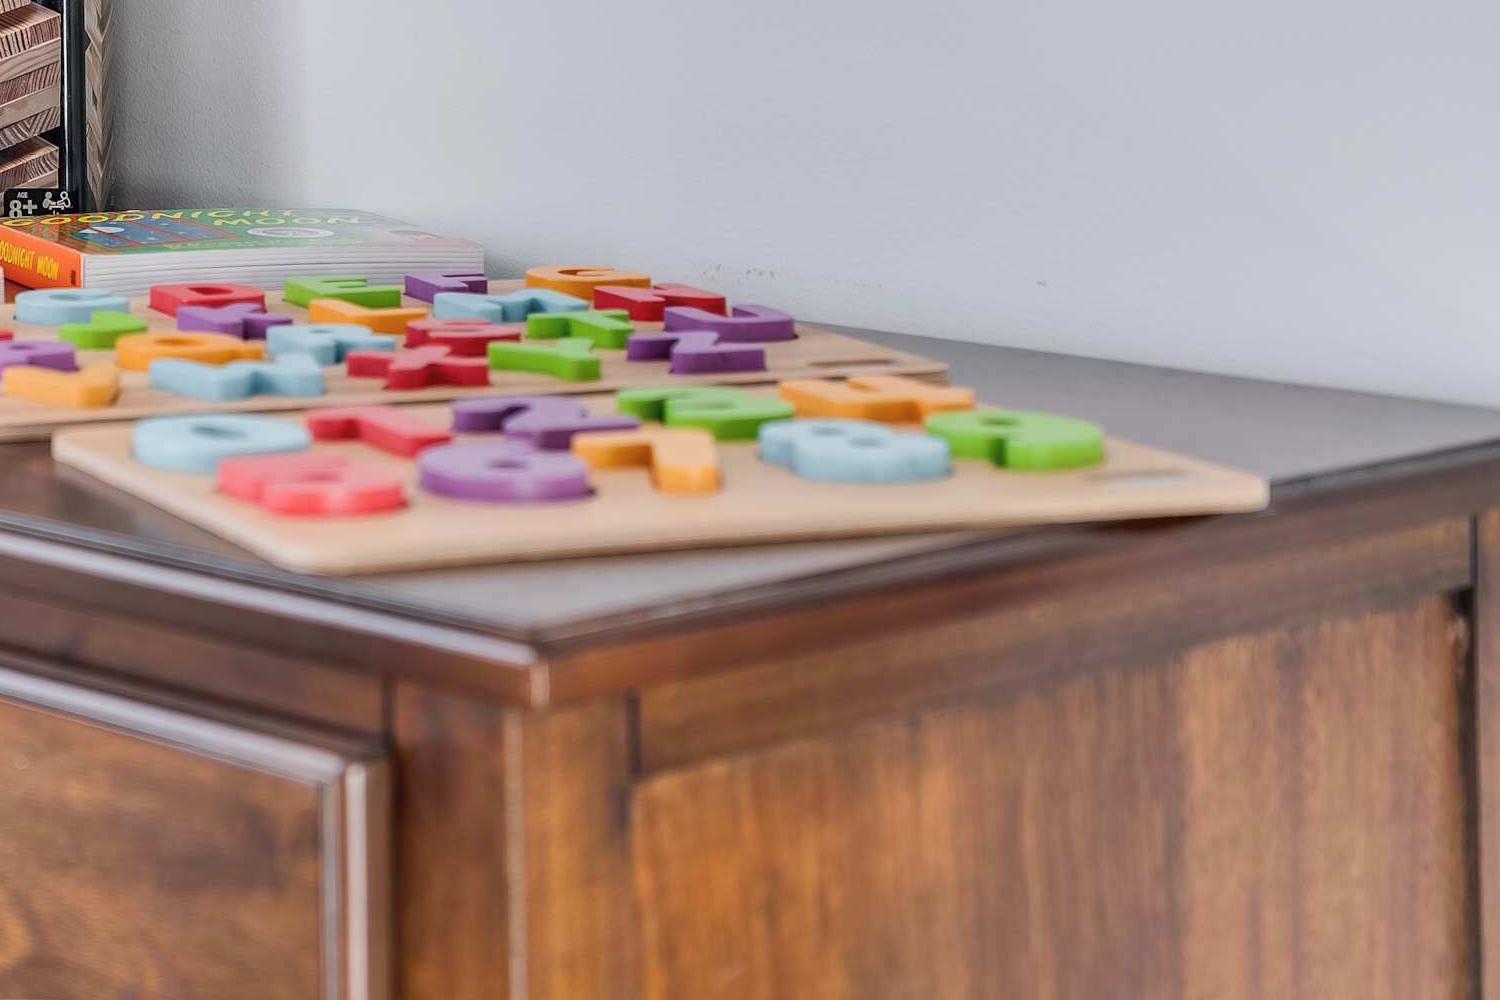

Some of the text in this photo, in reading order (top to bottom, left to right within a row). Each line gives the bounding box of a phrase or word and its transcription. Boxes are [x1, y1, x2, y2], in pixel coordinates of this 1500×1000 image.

[17, 191, 29, 199] AGE
[9, 200, 39, 218] 8+
[37, 255, 59, 280] MOON
